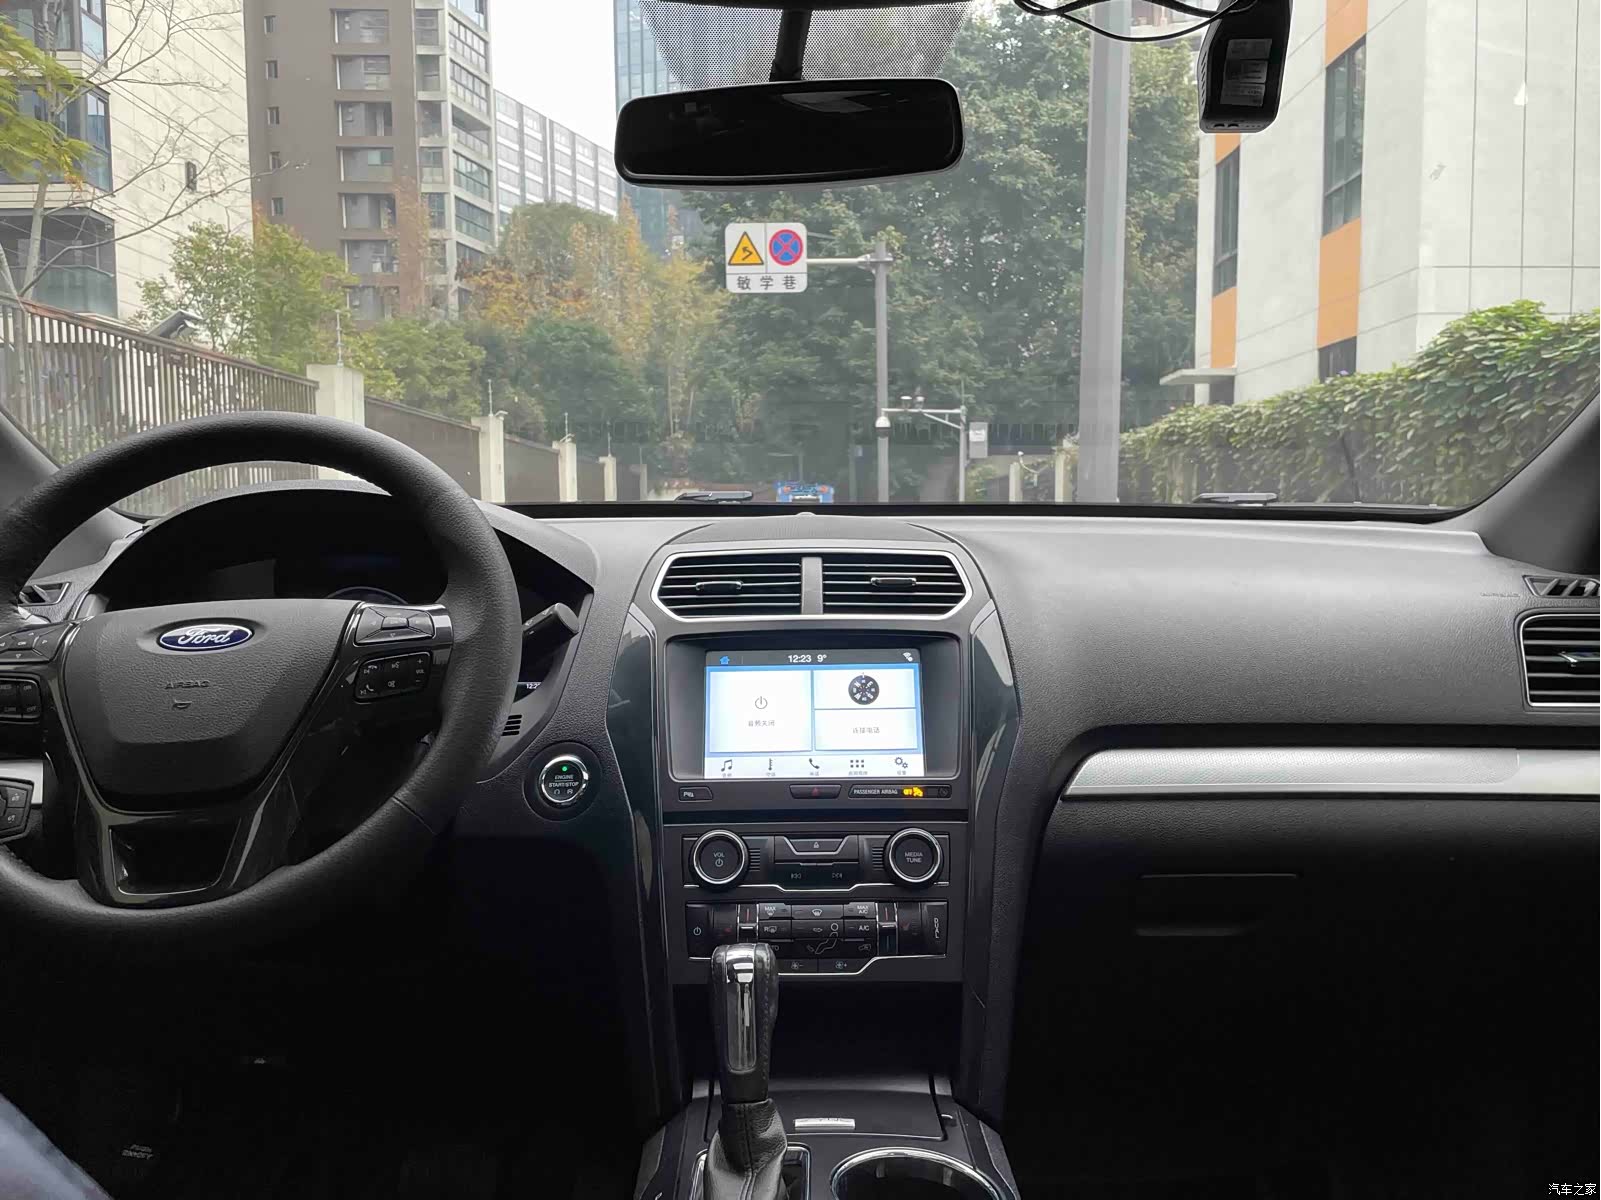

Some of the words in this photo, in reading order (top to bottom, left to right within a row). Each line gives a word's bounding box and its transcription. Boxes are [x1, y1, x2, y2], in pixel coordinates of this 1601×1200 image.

[737, 275, 796, 290] 敏学巷
[177, 627, 234, 645] Ford
[788, 654, 811, 663] 12:23
